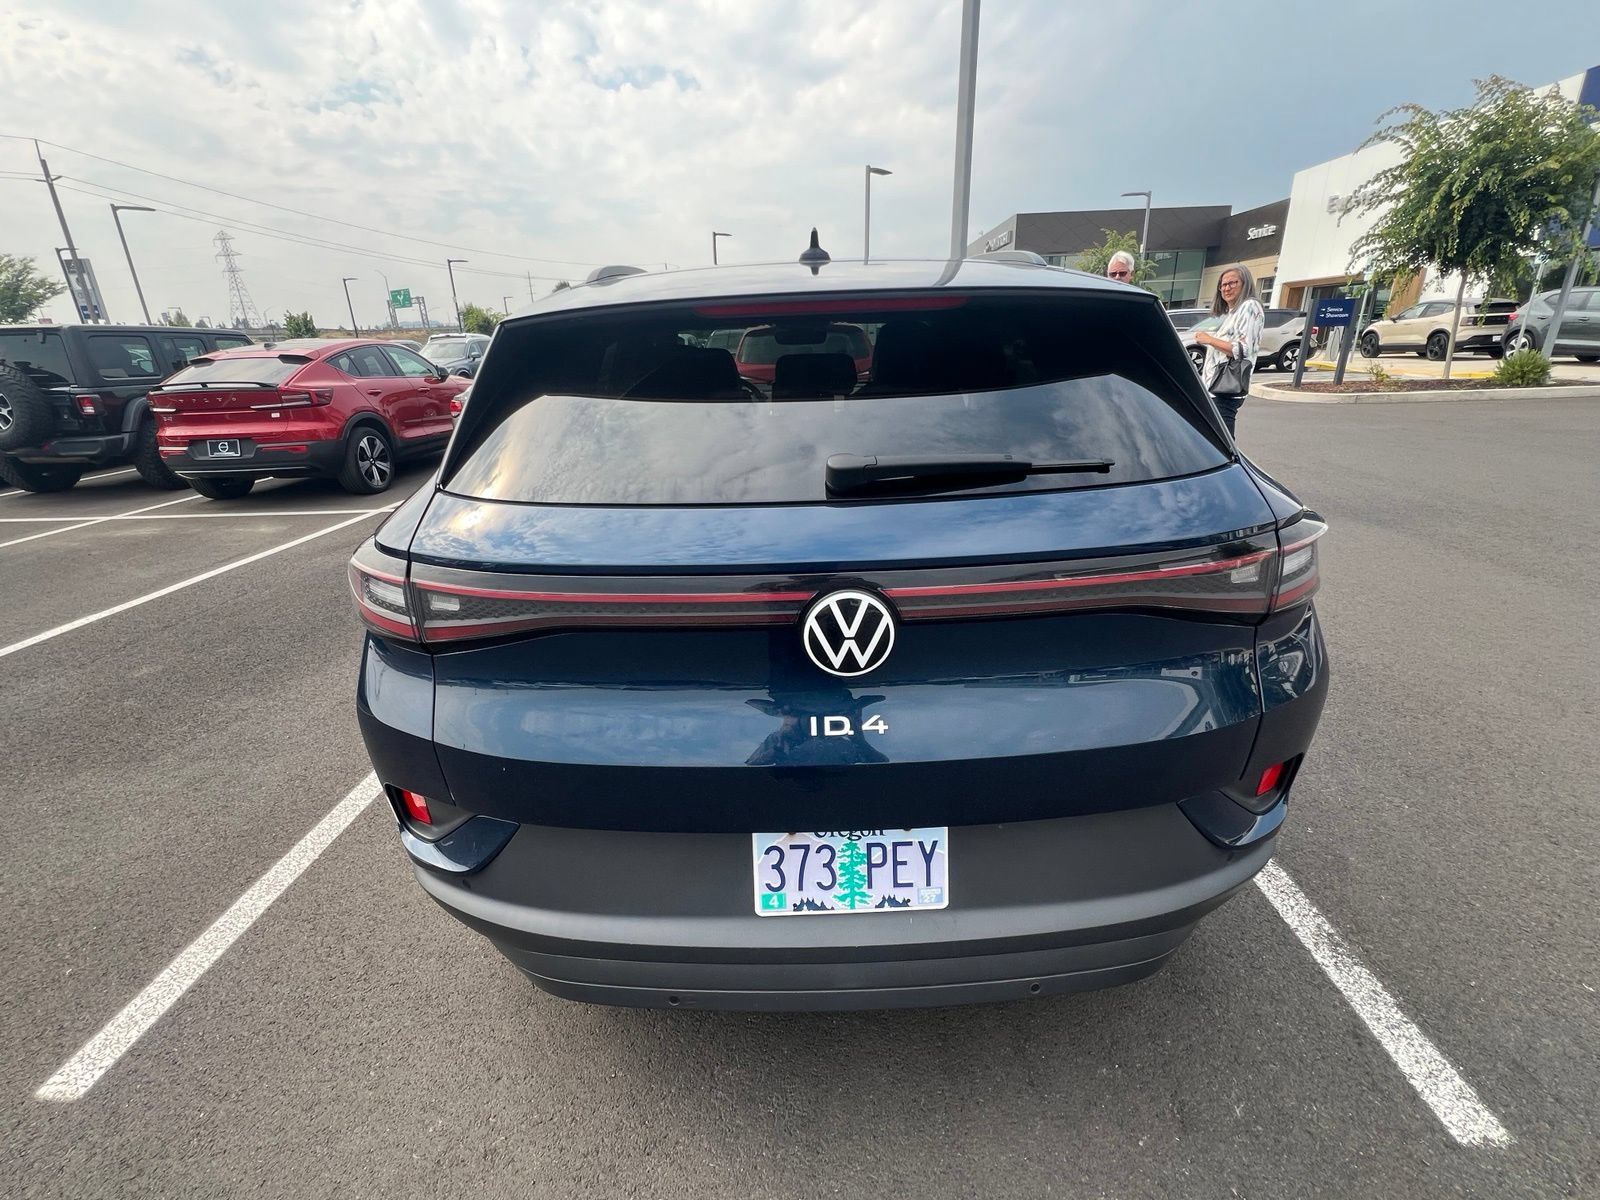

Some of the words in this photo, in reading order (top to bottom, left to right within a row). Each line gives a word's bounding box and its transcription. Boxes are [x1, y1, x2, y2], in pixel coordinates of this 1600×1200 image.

[1247, 224, 1276, 240] Service
[763, 844, 837, 892] 373
[866, 840, 939, 890] PEY
[768, 897, 780, 908] 4
